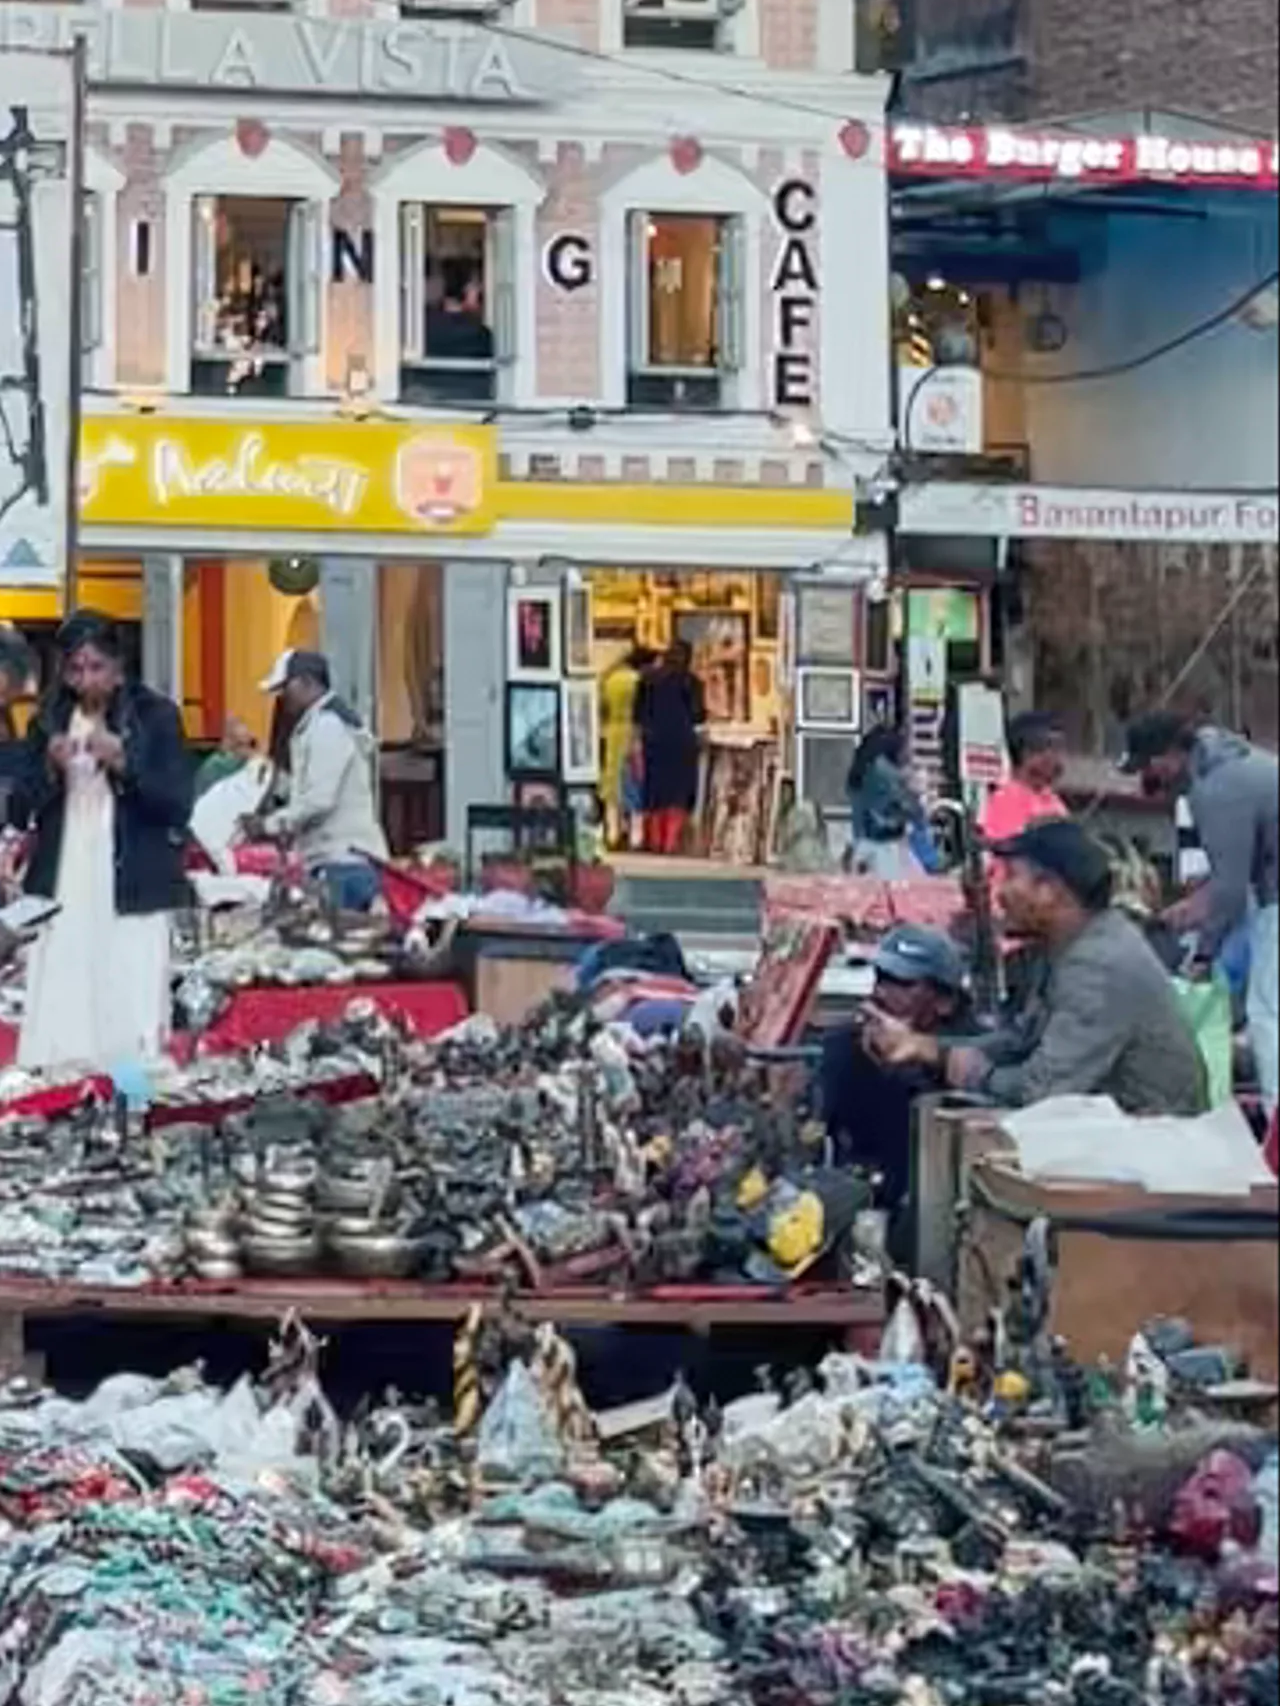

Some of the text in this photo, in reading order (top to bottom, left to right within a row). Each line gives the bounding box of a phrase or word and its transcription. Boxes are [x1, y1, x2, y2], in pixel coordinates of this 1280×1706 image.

[295, 15, 534, 97] VISTA
[892, 124, 1261, 175] The Burger House
[770, 179, 819, 408] CAFE
[1019, 492, 1222, 534] Basantapur
